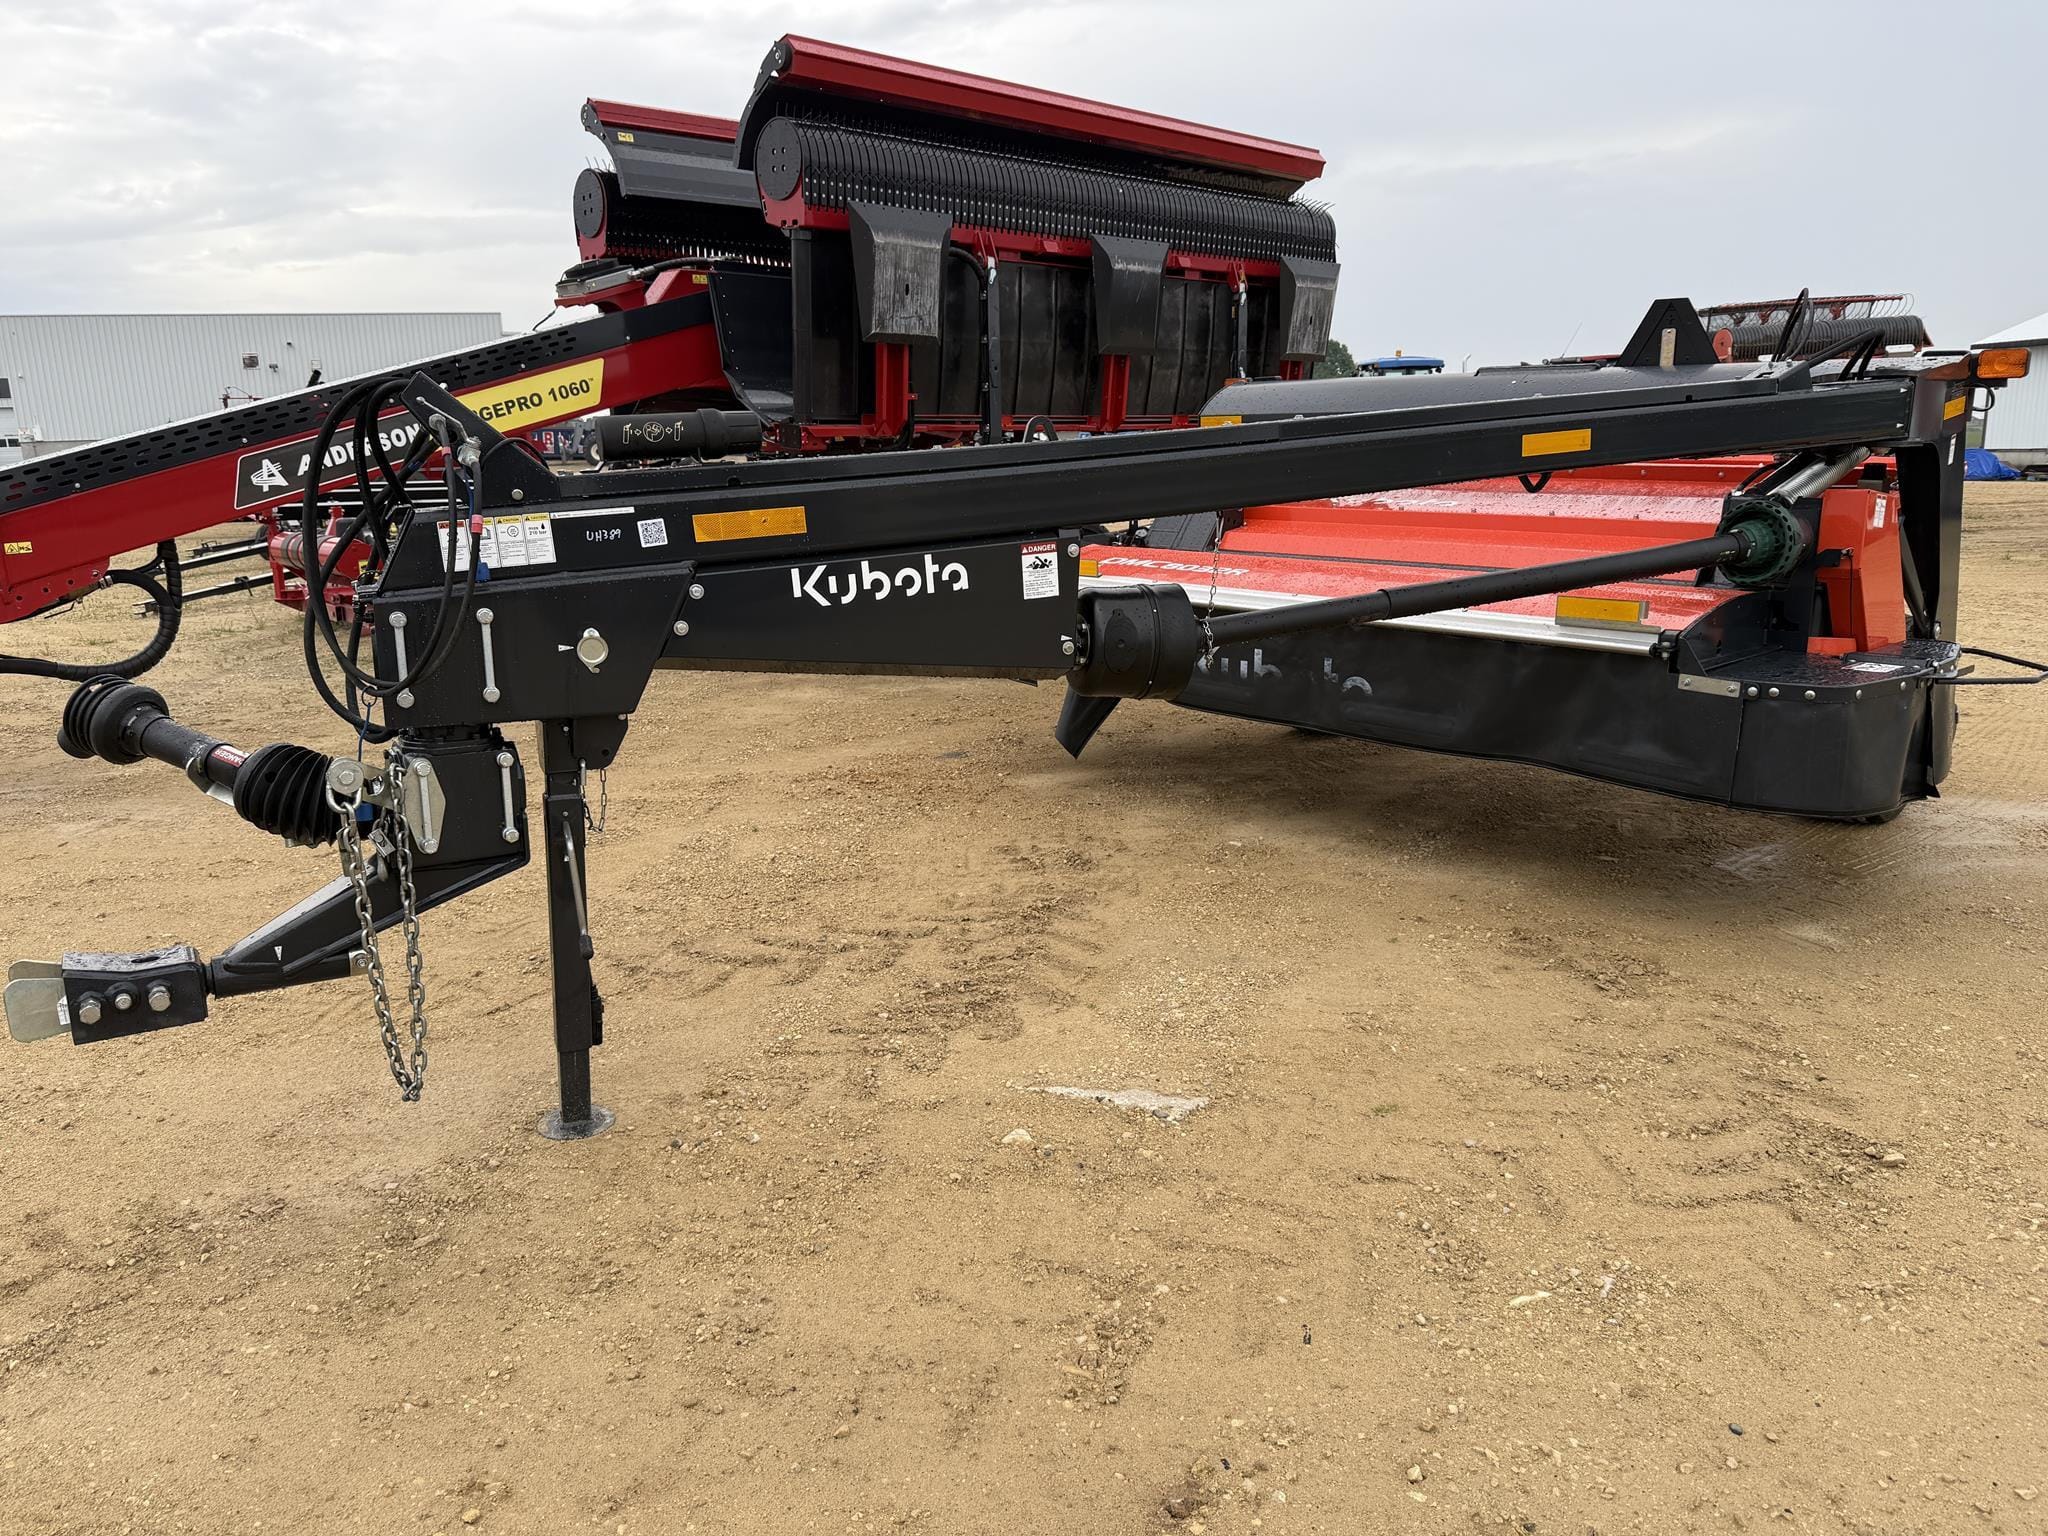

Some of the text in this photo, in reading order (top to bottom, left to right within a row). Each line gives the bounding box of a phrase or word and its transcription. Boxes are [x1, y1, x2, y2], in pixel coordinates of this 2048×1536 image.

[473, 392, 543, 420] GEPRO
[586, 528, 621, 542] UH389
[1028, 543, 1057, 553] DANGER
[791, 554, 969, 607] Kubota
